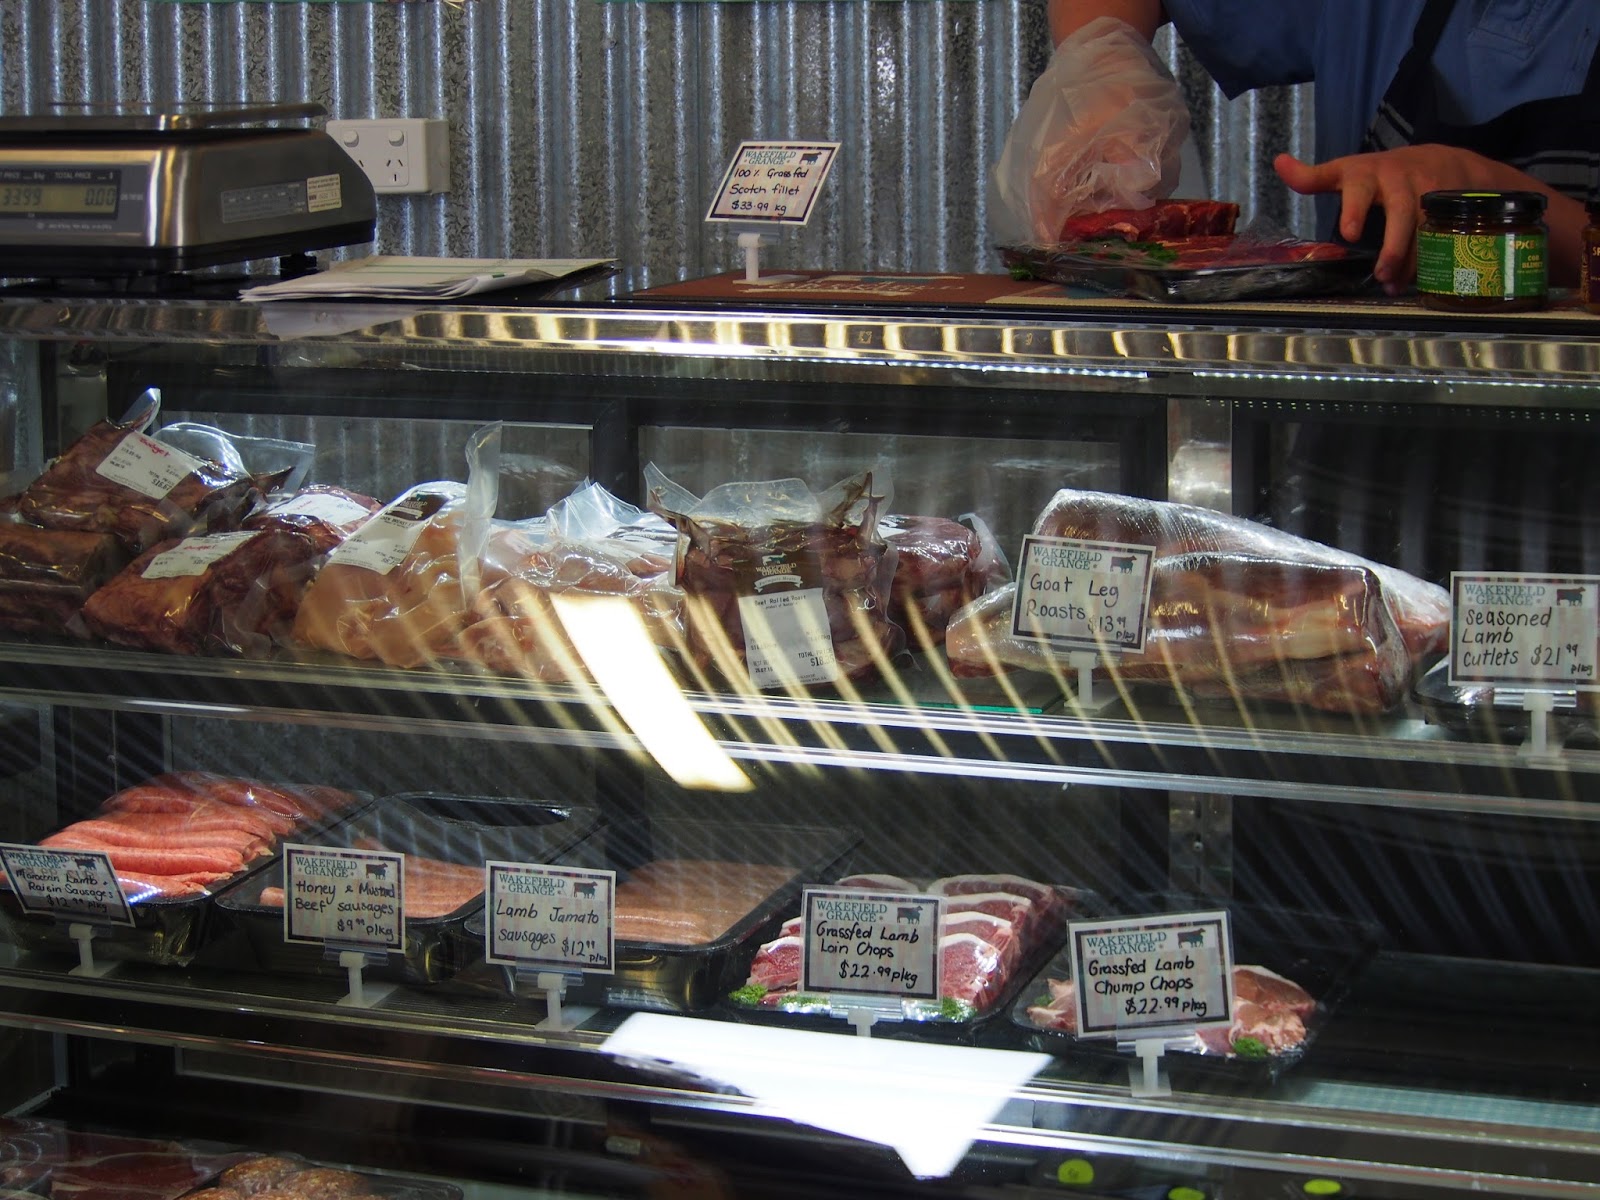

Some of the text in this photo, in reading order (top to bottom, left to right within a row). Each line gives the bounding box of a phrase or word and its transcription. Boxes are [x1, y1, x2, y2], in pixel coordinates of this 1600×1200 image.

[729, 184, 800, 195] Scotch fillet
[731, 200, 787, 216] $33.99 kg
[1033, 546, 1102, 562] WAKEFIELD
[1041, 557, 1091, 570] GRANGE
[1030, 573, 1119, 608] Goat Leg
[1464, 584, 1546, 596] WAKEFIELD
[1476, 595, 1533, 606] GRANGE
[1026, 598, 1086, 620] Roasts
[1466, 606, 1552, 628] Seasoned
[1462, 627, 1514, 644] Lamb
[19, 860, 61, 869] GRANGE
[295, 856, 357, 870] WAKEFIELD
[66, 873, 98, 885] Lamb
[304, 866, 349, 878] GRANGE
[499, 873, 565, 889] WAKEFIELD
[28, 882, 114, 901] Raisin Sausages
[296, 880, 336, 905] Honey
[508, 884, 556, 896] GRANGE
[295, 898, 327, 913] Beef
[496, 899, 538, 918] Lamb
[817, 900, 888, 914] WAKEFIELD
[826, 911, 877, 923] GRANGE
[816, 920, 919, 944] Grassfed Lamb
[1086, 932, 1167, 948] WAKEFIELD
[820, 938, 894, 959] Loin Chops
[1099, 942, 1156, 956] GRANGE
[1089, 955, 1195, 976] Grassfed Lamb
[1095, 976, 1194, 995] Chump Chops
